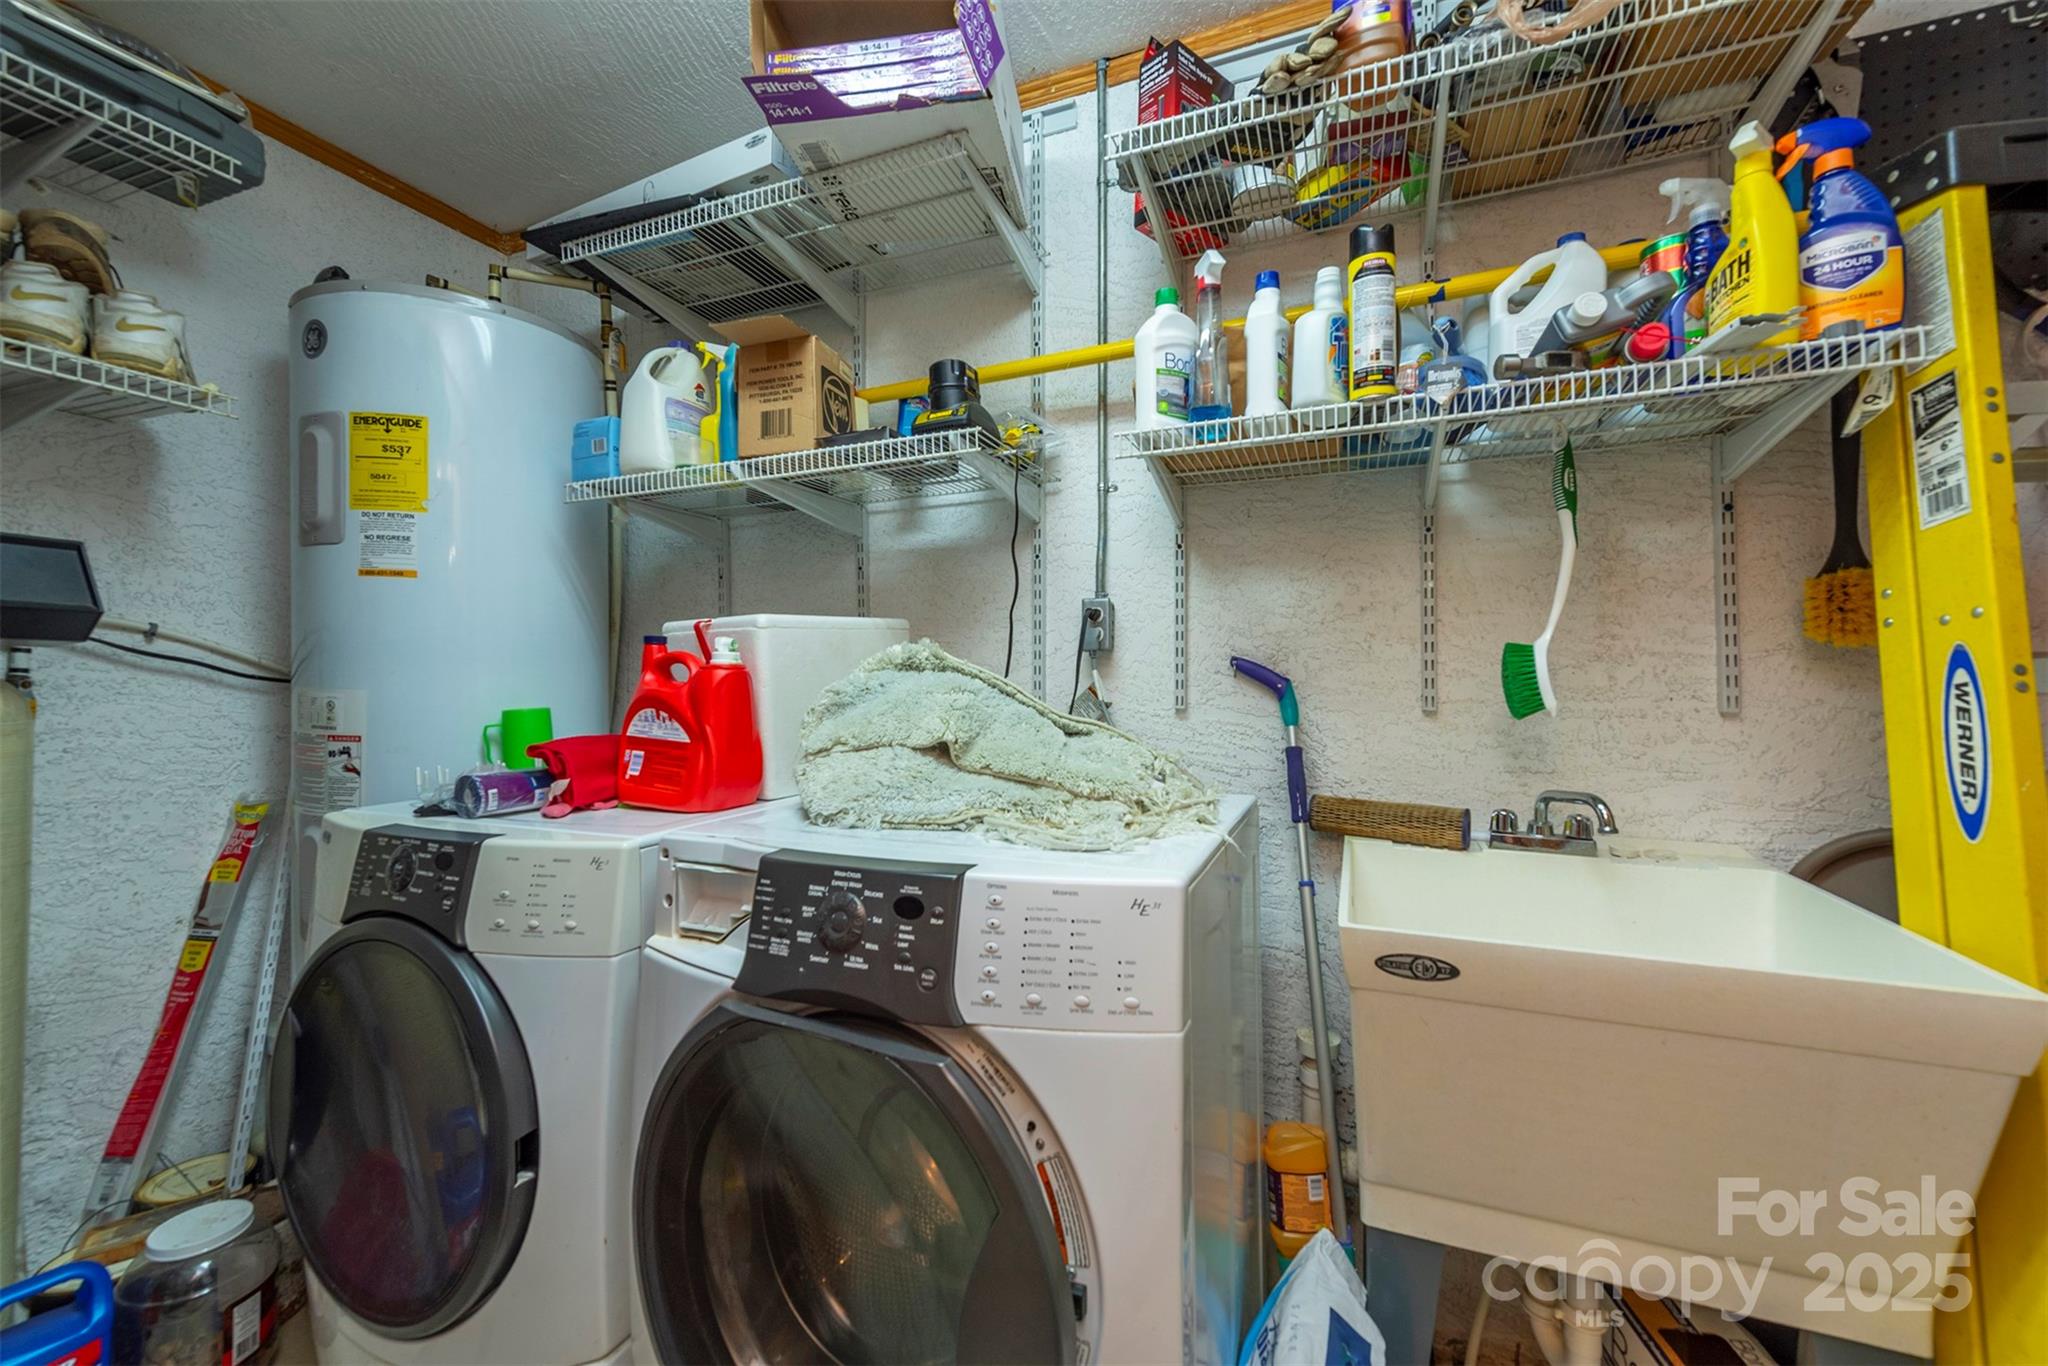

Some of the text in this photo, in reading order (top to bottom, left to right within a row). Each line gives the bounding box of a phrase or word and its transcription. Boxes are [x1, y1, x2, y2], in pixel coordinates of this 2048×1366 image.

[751, 80, 818, 94] Filtrete
[1711, 248, 1751, 305] BATH
[1814, 264, 1831, 277] 24
[1832, 254, 1874, 272] HOUR
[381, 444, 412, 454] $537
[1954, 681, 1977, 800] WERNER
